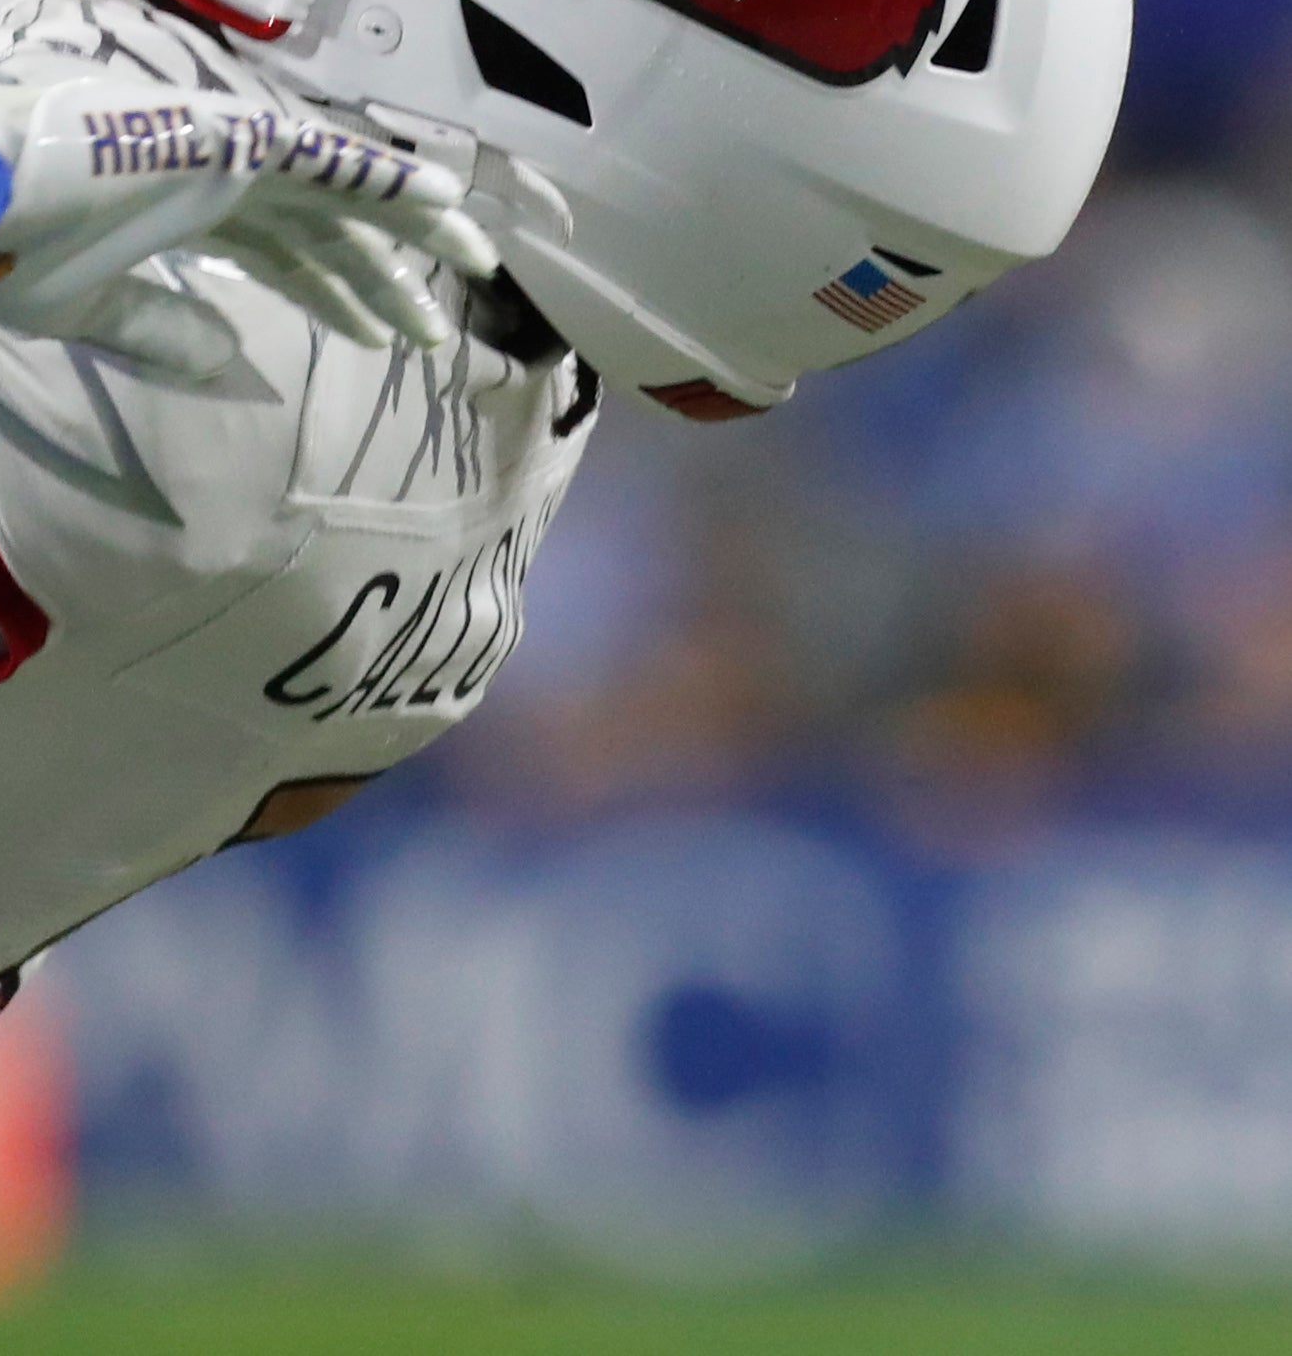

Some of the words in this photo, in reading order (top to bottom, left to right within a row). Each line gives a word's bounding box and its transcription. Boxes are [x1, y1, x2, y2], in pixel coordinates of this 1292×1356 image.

[82, 104, 210, 177] HAIL
[216, 108, 276, 171] TO
[277, 119, 418, 202] PITT
[263, 492, 561, 722] CALLO
